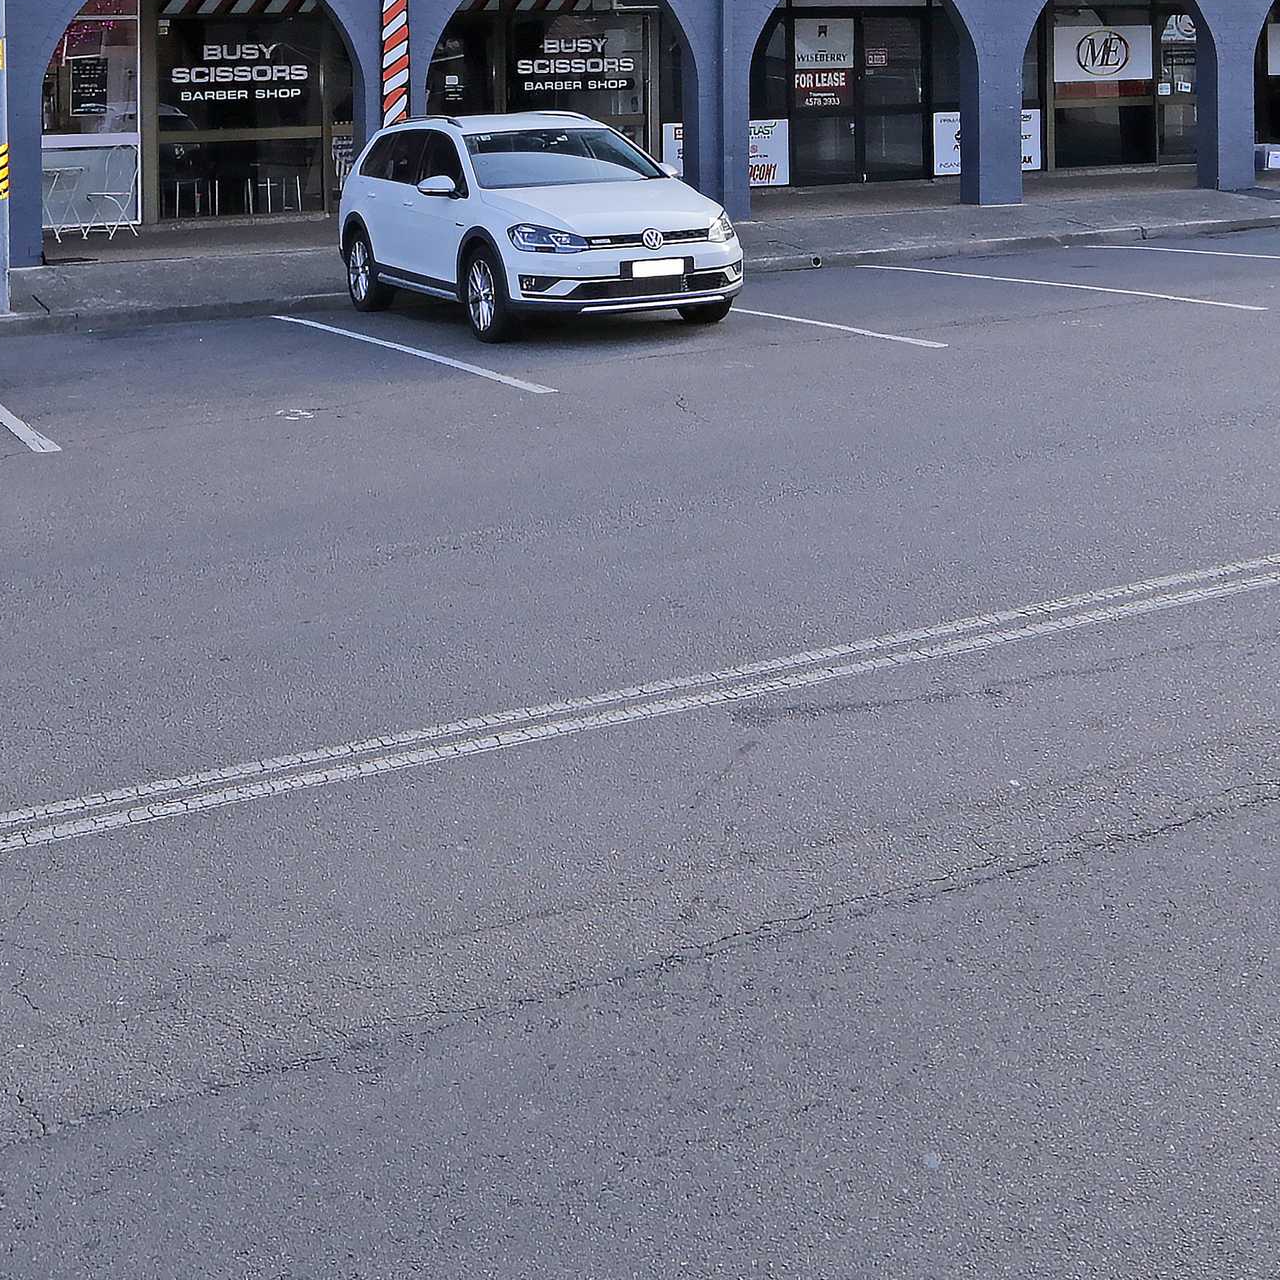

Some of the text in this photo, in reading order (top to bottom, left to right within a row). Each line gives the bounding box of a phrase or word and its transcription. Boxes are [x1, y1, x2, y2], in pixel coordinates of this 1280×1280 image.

[203, 43, 277, 61] BUSY
[543, 38, 608, 54] BUSY
[796, 52, 848, 63] WISEBERRY
[171, 65, 309, 84] SCISSORS
[517, 58, 635, 75] SCISSORS
[524, 79, 628, 91] BARBER SHOP
[795, 72, 846, 89] FOR LEASE
[181, 88, 302, 102] BARBER SHOP
